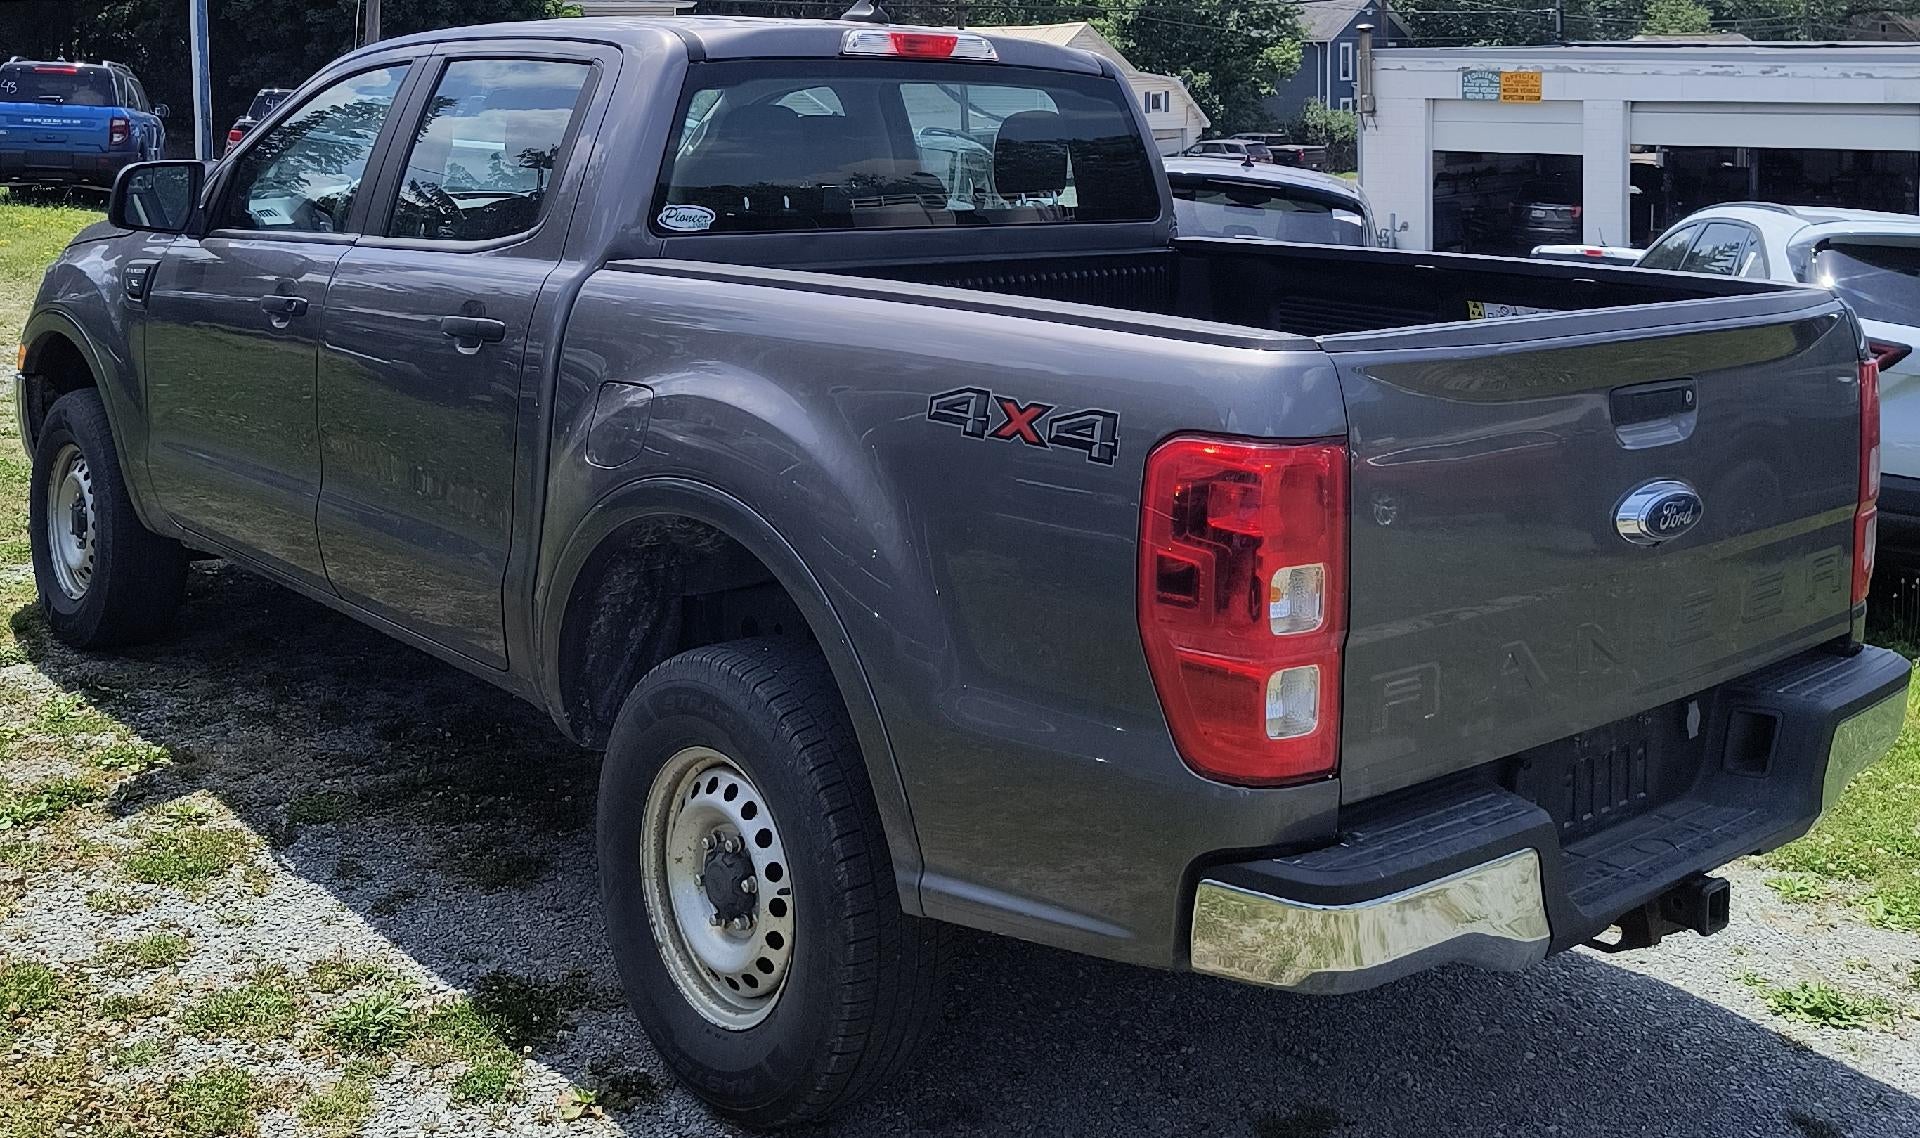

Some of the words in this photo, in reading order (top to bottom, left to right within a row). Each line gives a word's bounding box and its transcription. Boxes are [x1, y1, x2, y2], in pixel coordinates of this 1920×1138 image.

[1505, 74, 1540, 82] OFFICIAL
[1, 79, 17, 94] 43
[664, 207, 709, 222] Pioneer
[1660, 500, 1695, 530] Ford
[1369, 544, 1842, 733] RANGER
